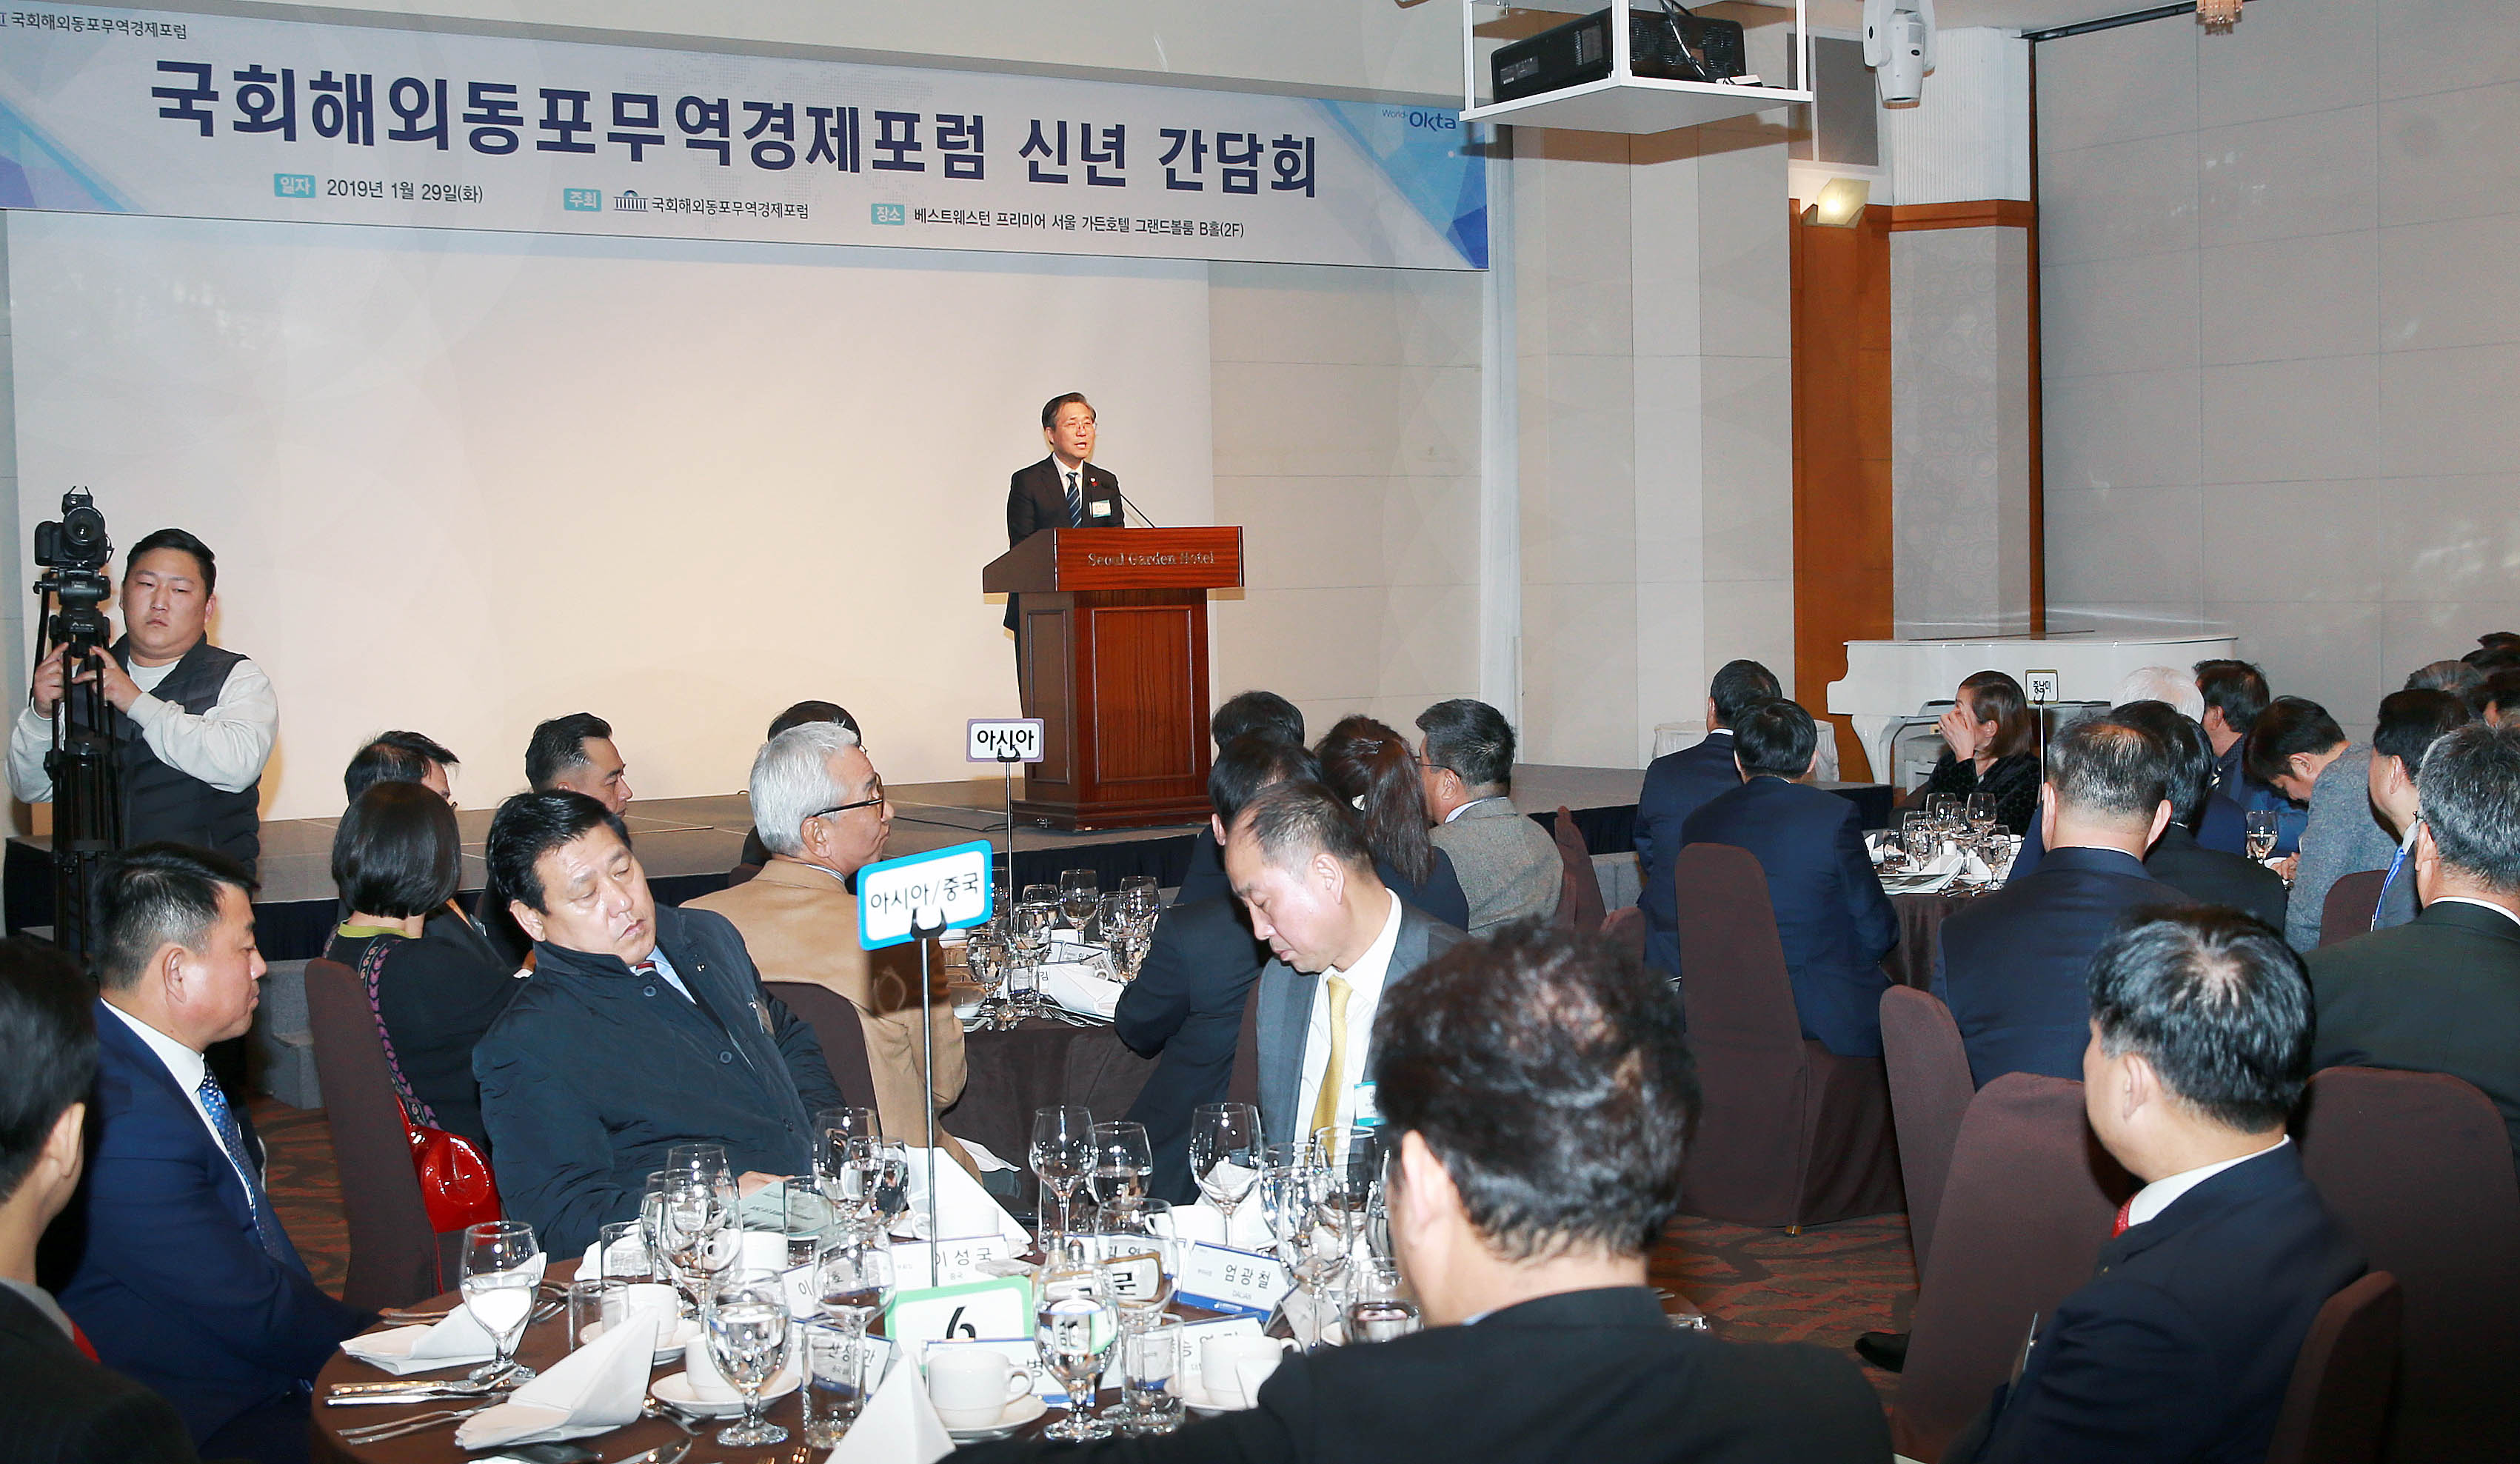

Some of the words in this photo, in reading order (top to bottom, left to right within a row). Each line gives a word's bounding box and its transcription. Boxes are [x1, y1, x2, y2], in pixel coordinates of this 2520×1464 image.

[11, 12, 187, 40] 국회해외동포무역경제포럼
[151, 60, 985, 181] 국회해외동포무역경제포럼
[1019, 119, 1126, 187] 신년
[1158, 128, 1315, 198] 간담회
[1409, 111, 1457, 132] Okta
[280, 177, 310, 195] 일자
[327, 179, 384, 198] 2019년
[391, 181, 415, 201] 1월
[421, 184, 484, 204] 29일(화)
[569, 190, 598, 209] 주최
[652, 196, 809, 220] 국회해외동포무역경제포럼
[877, 206, 901, 222] 장소
[915, 207, 991, 227] 베스트웨스턴
[996, 212, 1046, 230] 프리미어
[1052, 214, 1076, 230] 서울
[1082, 215, 1130, 233] 가든호텔
[1134, 219, 1194, 236] 그랜드볼룸
[1200, 221, 1245, 238] B홀(2F)
[1088, 552, 1125, 566] Seoul
[1128, 552, 1177, 566] Garden
[1180, 550, 1215, 565] Hotel
[977, 729, 1035, 751] 아시아
[871, 872, 978, 915] 아시아/중국
